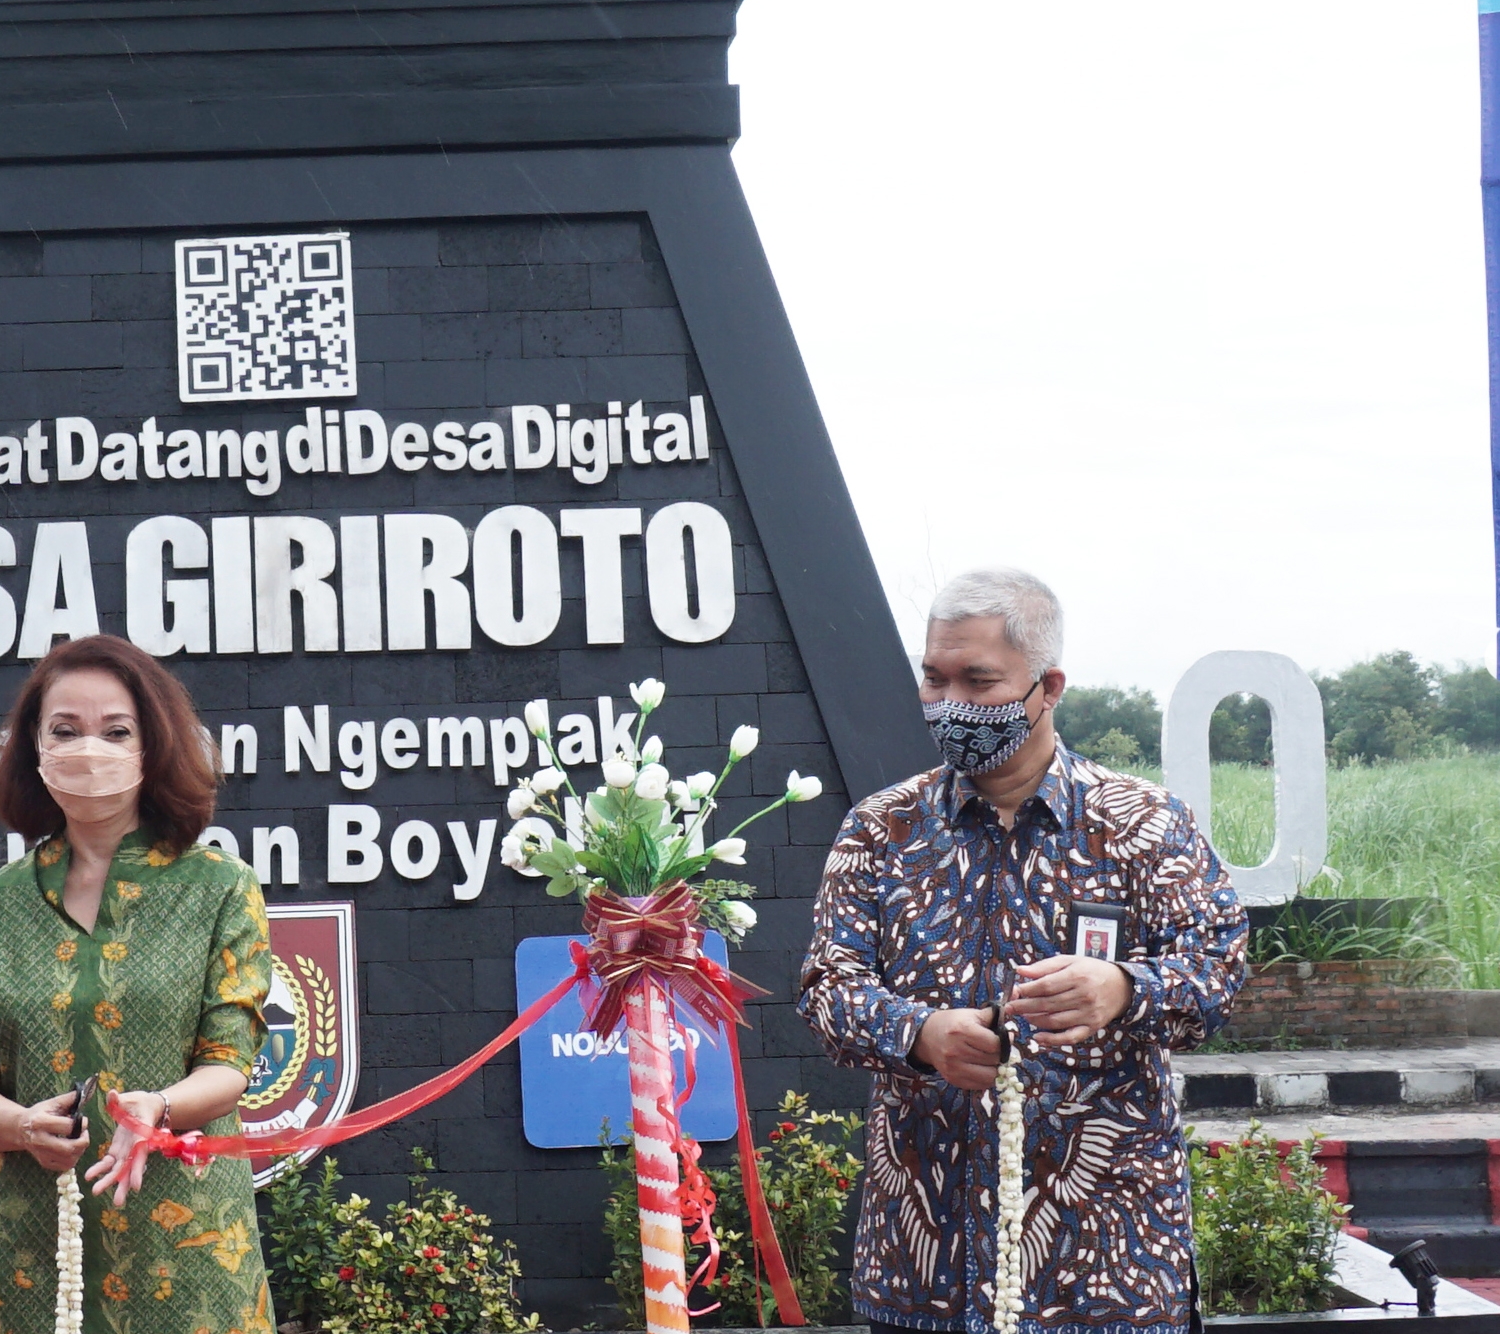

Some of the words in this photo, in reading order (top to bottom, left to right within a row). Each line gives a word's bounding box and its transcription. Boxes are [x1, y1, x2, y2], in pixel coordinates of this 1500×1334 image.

[55, 416, 281, 496] Datang
[343, 409, 508, 475] Desa
[511, 395, 709, 485] Digital
[125, 502, 735, 660] GIRIROTO
[284, 696, 642, 789] Ngemplak
